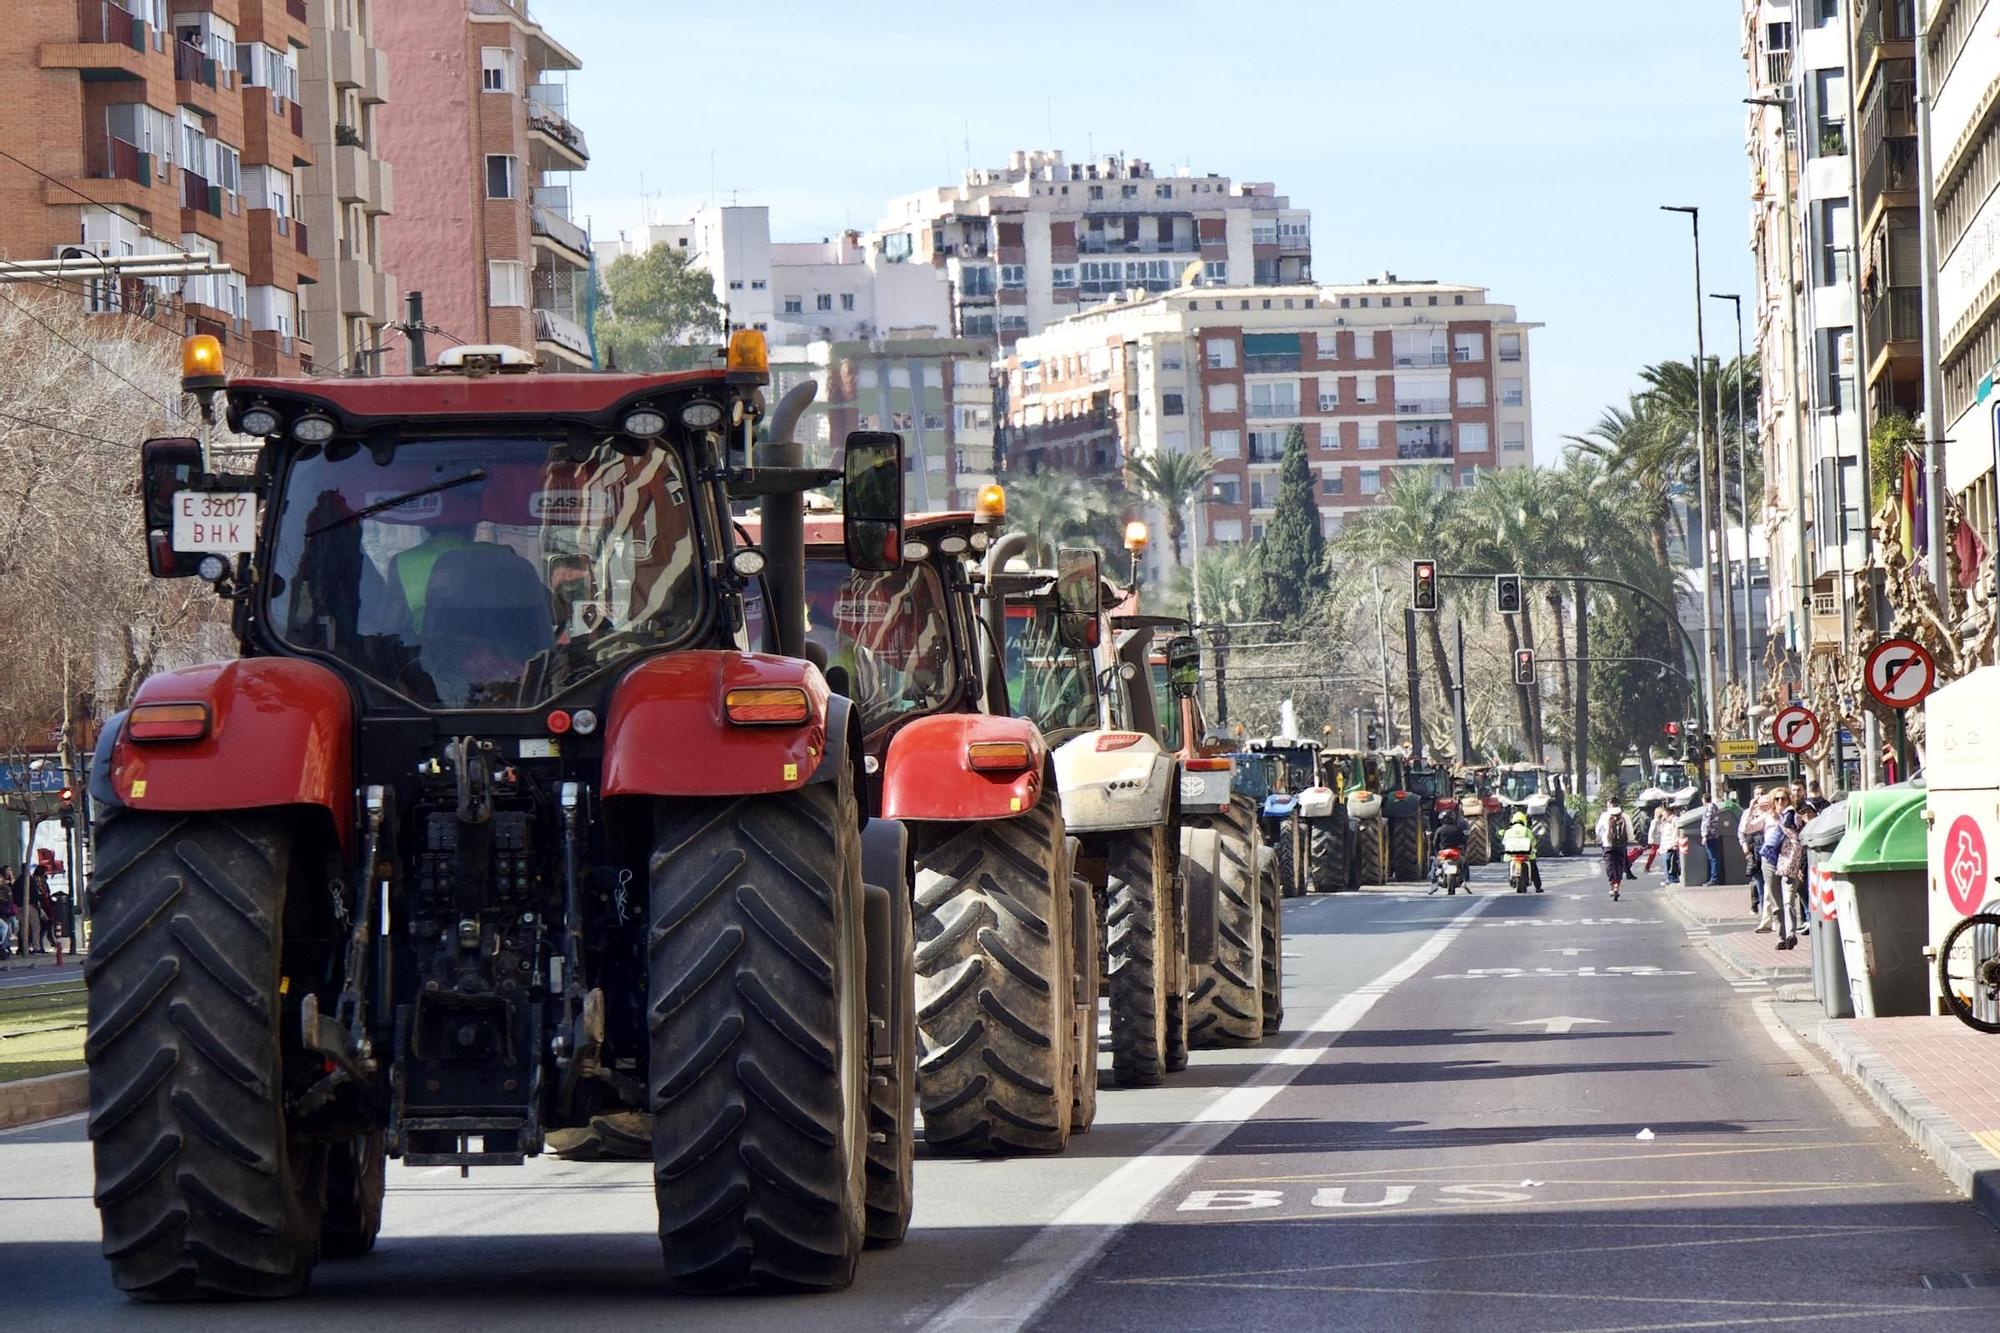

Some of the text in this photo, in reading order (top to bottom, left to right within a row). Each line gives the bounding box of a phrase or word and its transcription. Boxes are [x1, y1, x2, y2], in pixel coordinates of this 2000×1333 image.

[183, 498, 247, 517] E 3207
[538, 496, 592, 508] CASE
[193, 524, 240, 543] BHK
[838, 604, 876, 613] CASE
[1176, 1183, 1534, 1212] BUS
